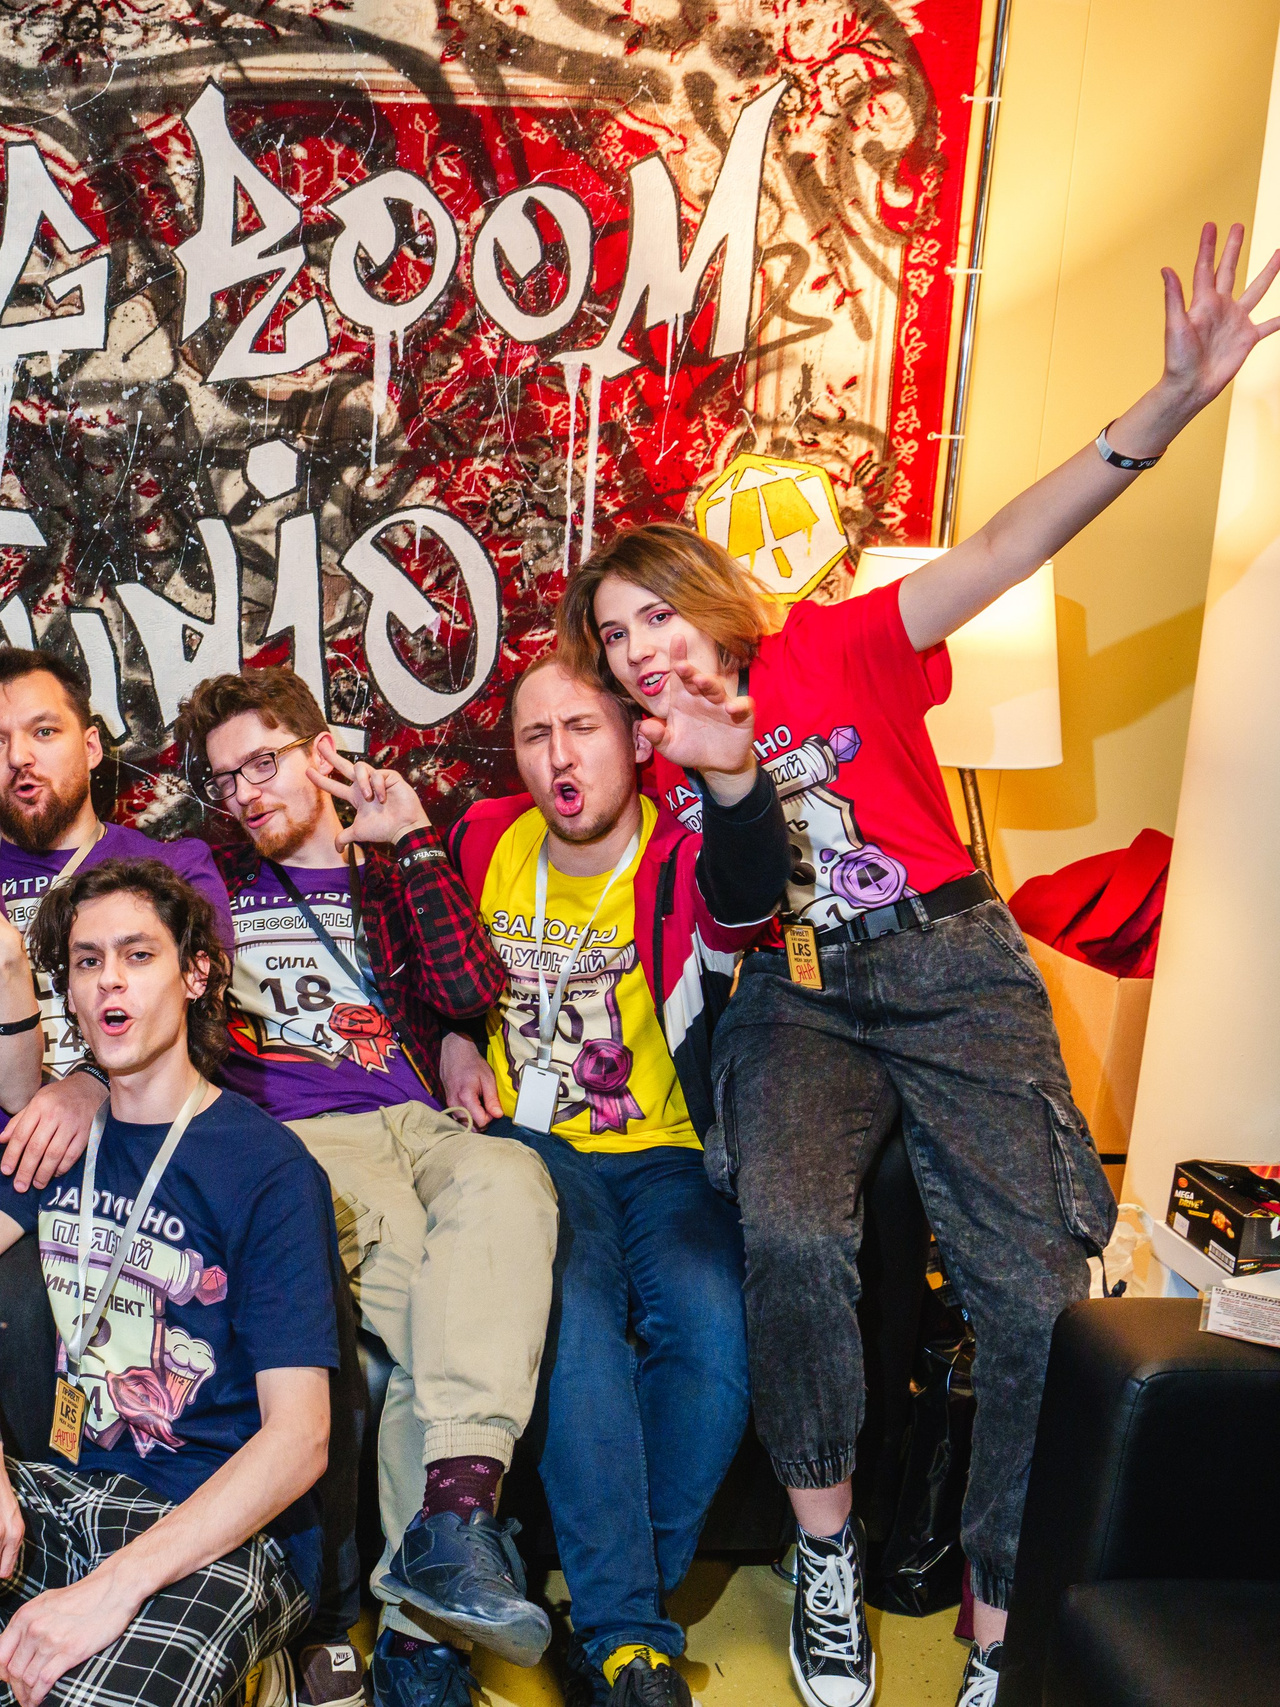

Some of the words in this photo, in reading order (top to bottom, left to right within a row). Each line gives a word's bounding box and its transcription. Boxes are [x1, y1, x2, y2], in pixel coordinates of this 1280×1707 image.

[172, 78, 790, 382] ROOM
[792, 942, 811, 957] LRS
[265, 956, 318, 971] СИЛА
[259, 974, 336, 1017] 18
[1174, 1189, 1194, 1200] MEGA
[52, 1218, 154, 1271] ПЬЯНЙ
[46, 1273, 145, 1318] ИНТЕЛЕКТ
[60, 1401, 77, 1424] LRS
[336, 1652, 349, 1660] NIKE
